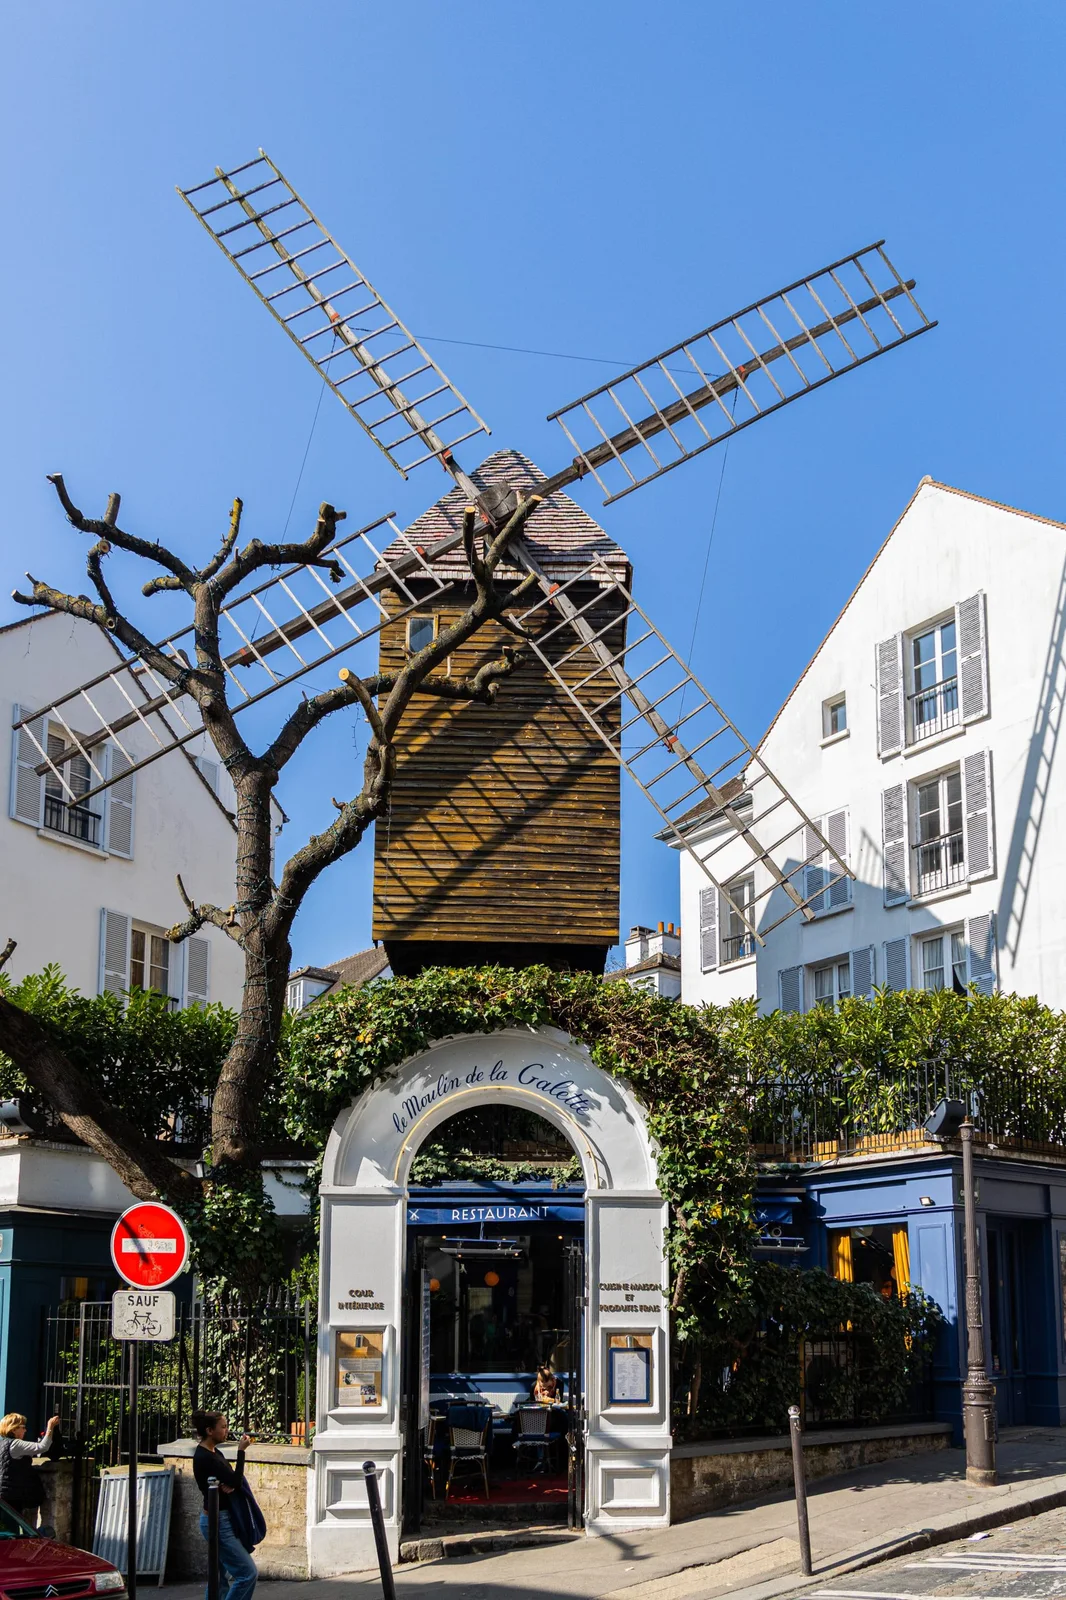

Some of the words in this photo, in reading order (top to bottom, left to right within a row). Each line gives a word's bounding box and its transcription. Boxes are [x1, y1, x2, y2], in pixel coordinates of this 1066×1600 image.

[392, 1112, 408, 1134] le
[402, 1074, 461, 1119] Moulin
[465, 1065, 485, 1084] de
[489, 1060, 509, 1082] la
[518, 1063, 590, 1116] Galette
[451, 1206, 550, 1221] RESTAURANT
[348, 1289, 375, 1298] COUR
[625, 1293, 635, 1302] ET
[127, 1295, 159, 1307] SAUF
[599, 1304, 639, 1313] PRODUITS
[639, 1304, 662, 1313] FRAIS
